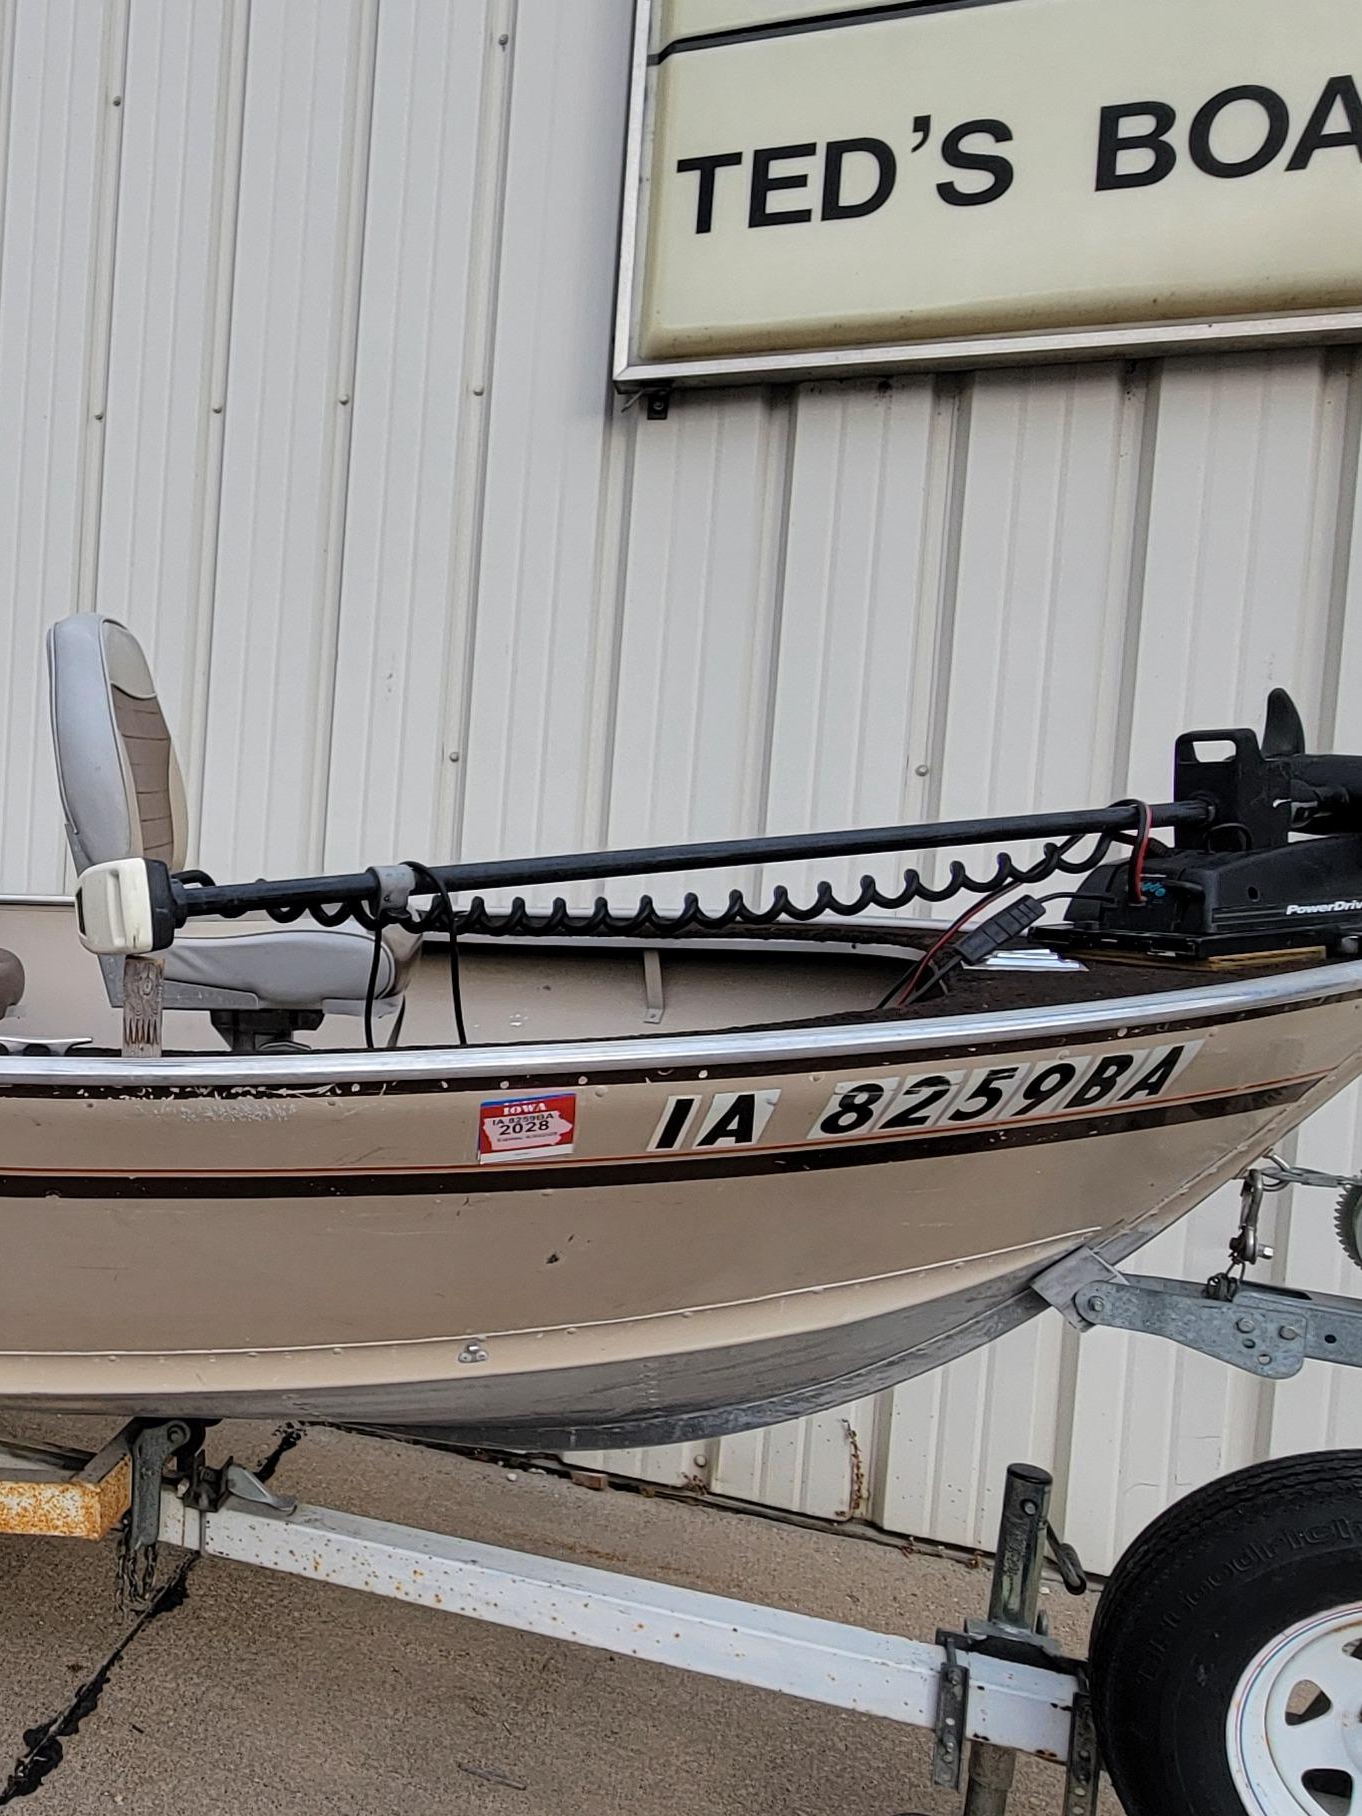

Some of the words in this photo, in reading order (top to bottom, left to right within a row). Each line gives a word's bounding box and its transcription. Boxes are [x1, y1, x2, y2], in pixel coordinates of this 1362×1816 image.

[677, 114, 1015, 234] TED'S
[1094, 74, 1362, 192] BOA
[503, 1103, 546, 1115] IOWA
[655, 1093, 756, 1150] IA
[820, 1045, 1185, 1135] 8259BA
[499, 1120, 549, 1136] 2028
